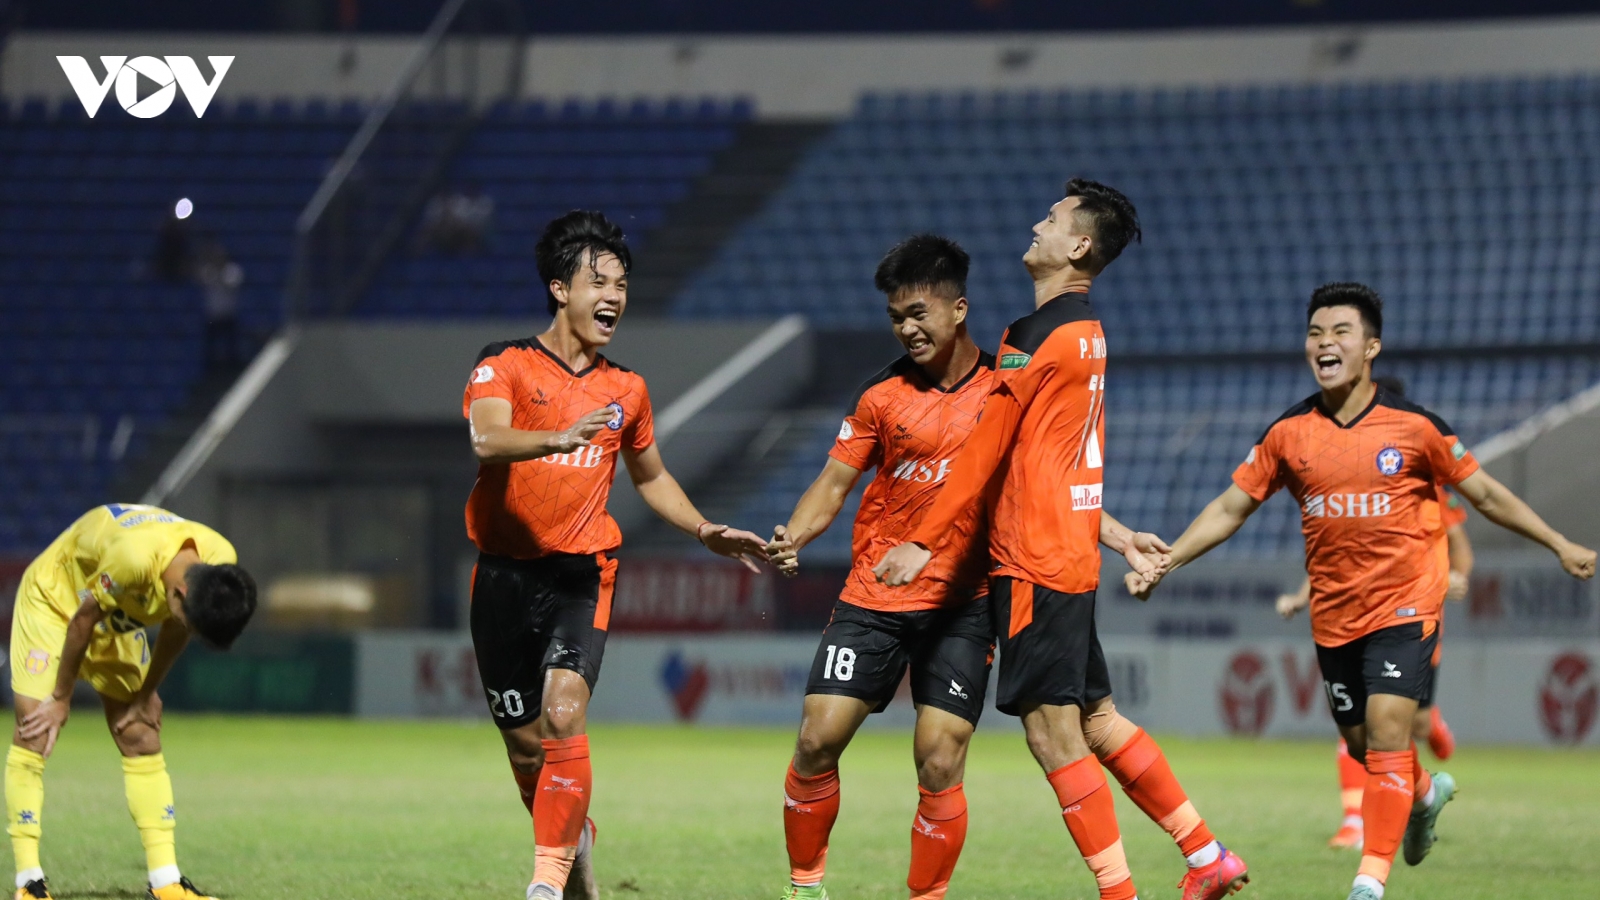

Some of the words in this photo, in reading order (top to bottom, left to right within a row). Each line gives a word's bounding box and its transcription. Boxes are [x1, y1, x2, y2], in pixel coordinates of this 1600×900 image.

[1327, 492, 1391, 518] SHB
[823, 644, 857, 682] 18
[487, 687, 525, 718] 20
